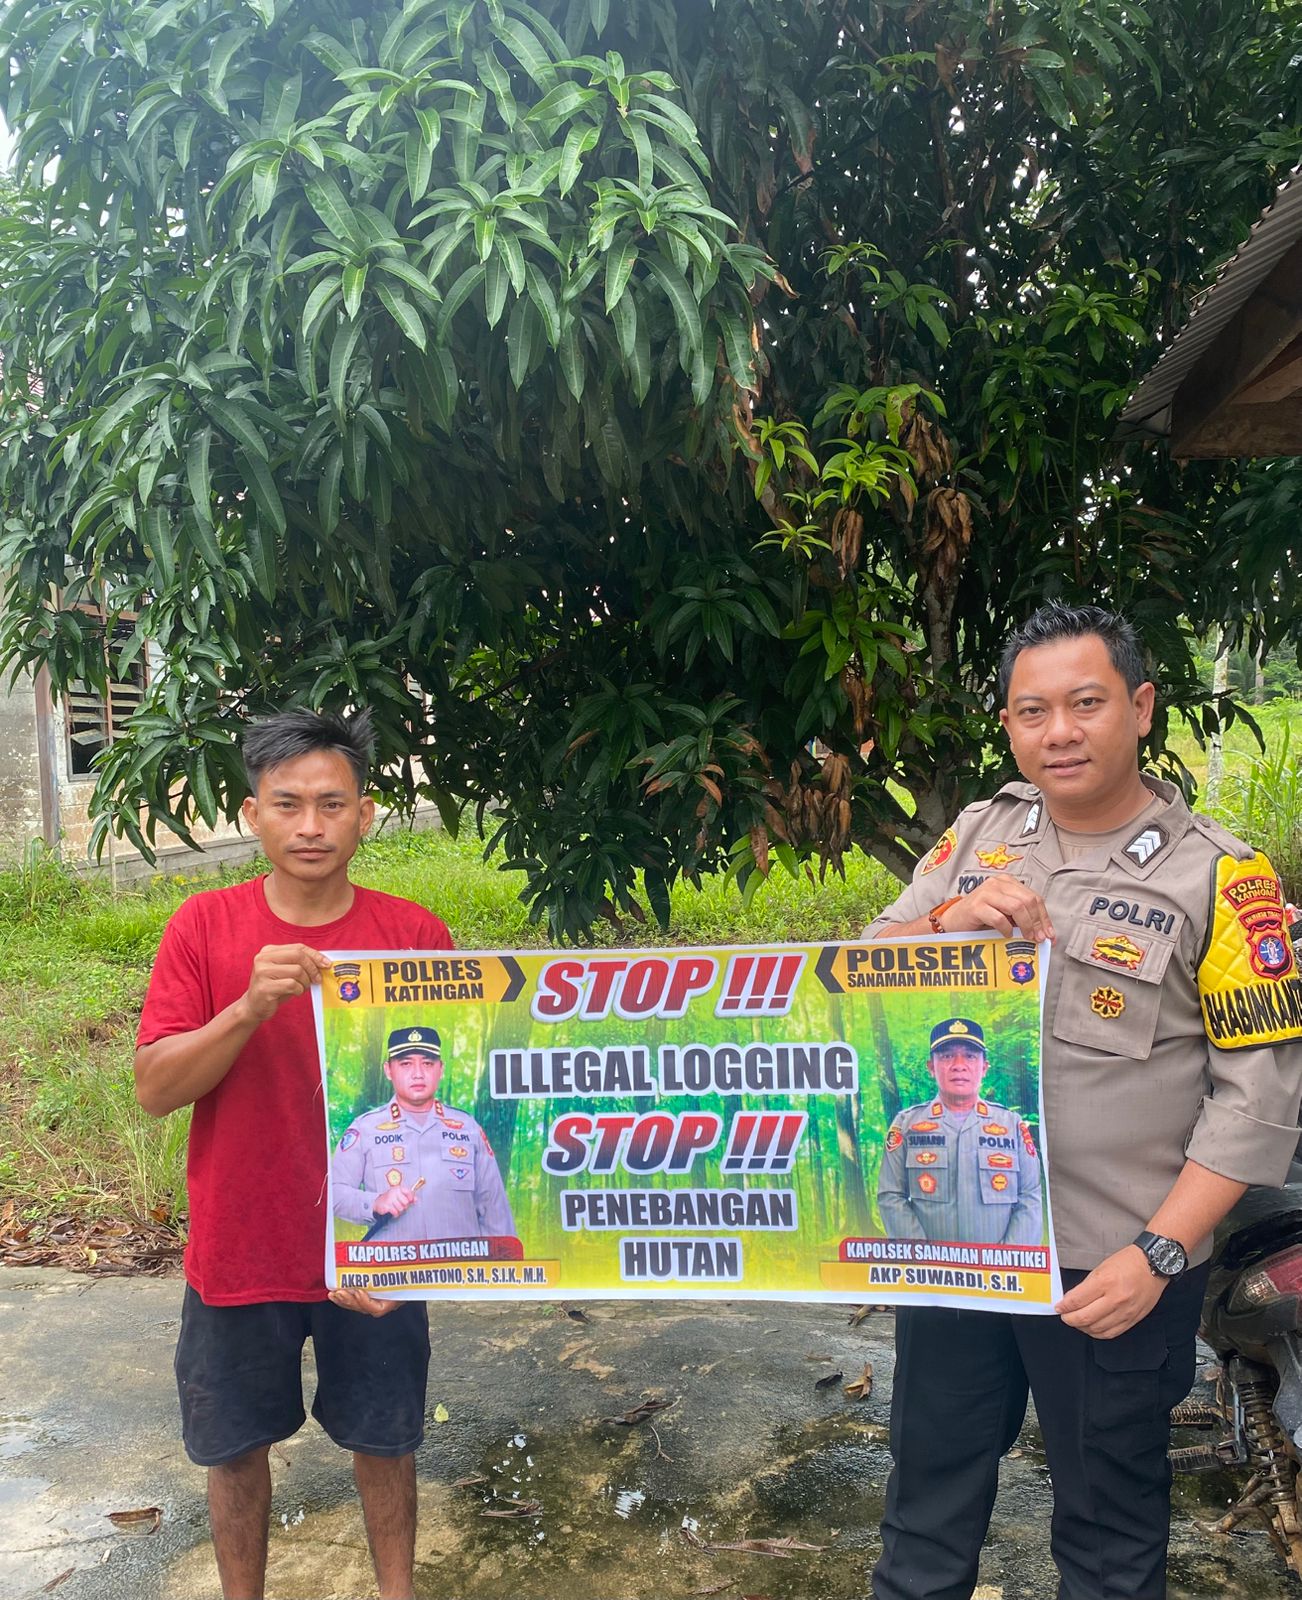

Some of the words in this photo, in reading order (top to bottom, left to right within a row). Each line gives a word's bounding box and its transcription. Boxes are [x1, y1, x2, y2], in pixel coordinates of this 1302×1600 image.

[1089, 896, 1175, 934] POLRI
[383, 959, 482, 983] POLRES
[846, 944, 987, 972] POLSEK
[536, 958, 719, 1016] STOP
[721, 955, 803, 1011] !!!
[847, 971, 917, 988] SANAMAN
[920, 970, 989, 986] MANTIKEI
[384, 983, 484, 1002] KATINGAN
[494, 1050, 654, 1094] ILLEGAL
[663, 1046, 855, 1094] LOGGING
[374, 1134, 404, 1145] DODIK
[441, 1131, 470, 1142] POLRI
[546, 1115, 720, 1172] STOP
[724, 1115, 804, 1170] !!!
[978, 1136, 1015, 1149] POLRI
[564, 1192, 793, 1227] PENEBANGAN
[348, 1246, 417, 1263] KAPOLRES
[419, 1240, 489, 1259] KATINGAN
[624, 1241, 738, 1277] HUTAN
[846, 1242, 913, 1260] KAPOLSEK
[914, 1244, 979, 1265] SANAMAN
[981, 1249, 1047, 1269] MANTIKEI
[340, 1274, 370, 1289] AKBP
[372, 1271, 408, 1286] DODIK
[410, 1268, 465, 1284] HARTONO,
[523, 1267, 547, 1283] M.H.
[870, 1266, 901, 1283] AKP
[904, 1269, 988, 1290] SUWARDI,
[990, 1274, 1023, 1292] S.H.
